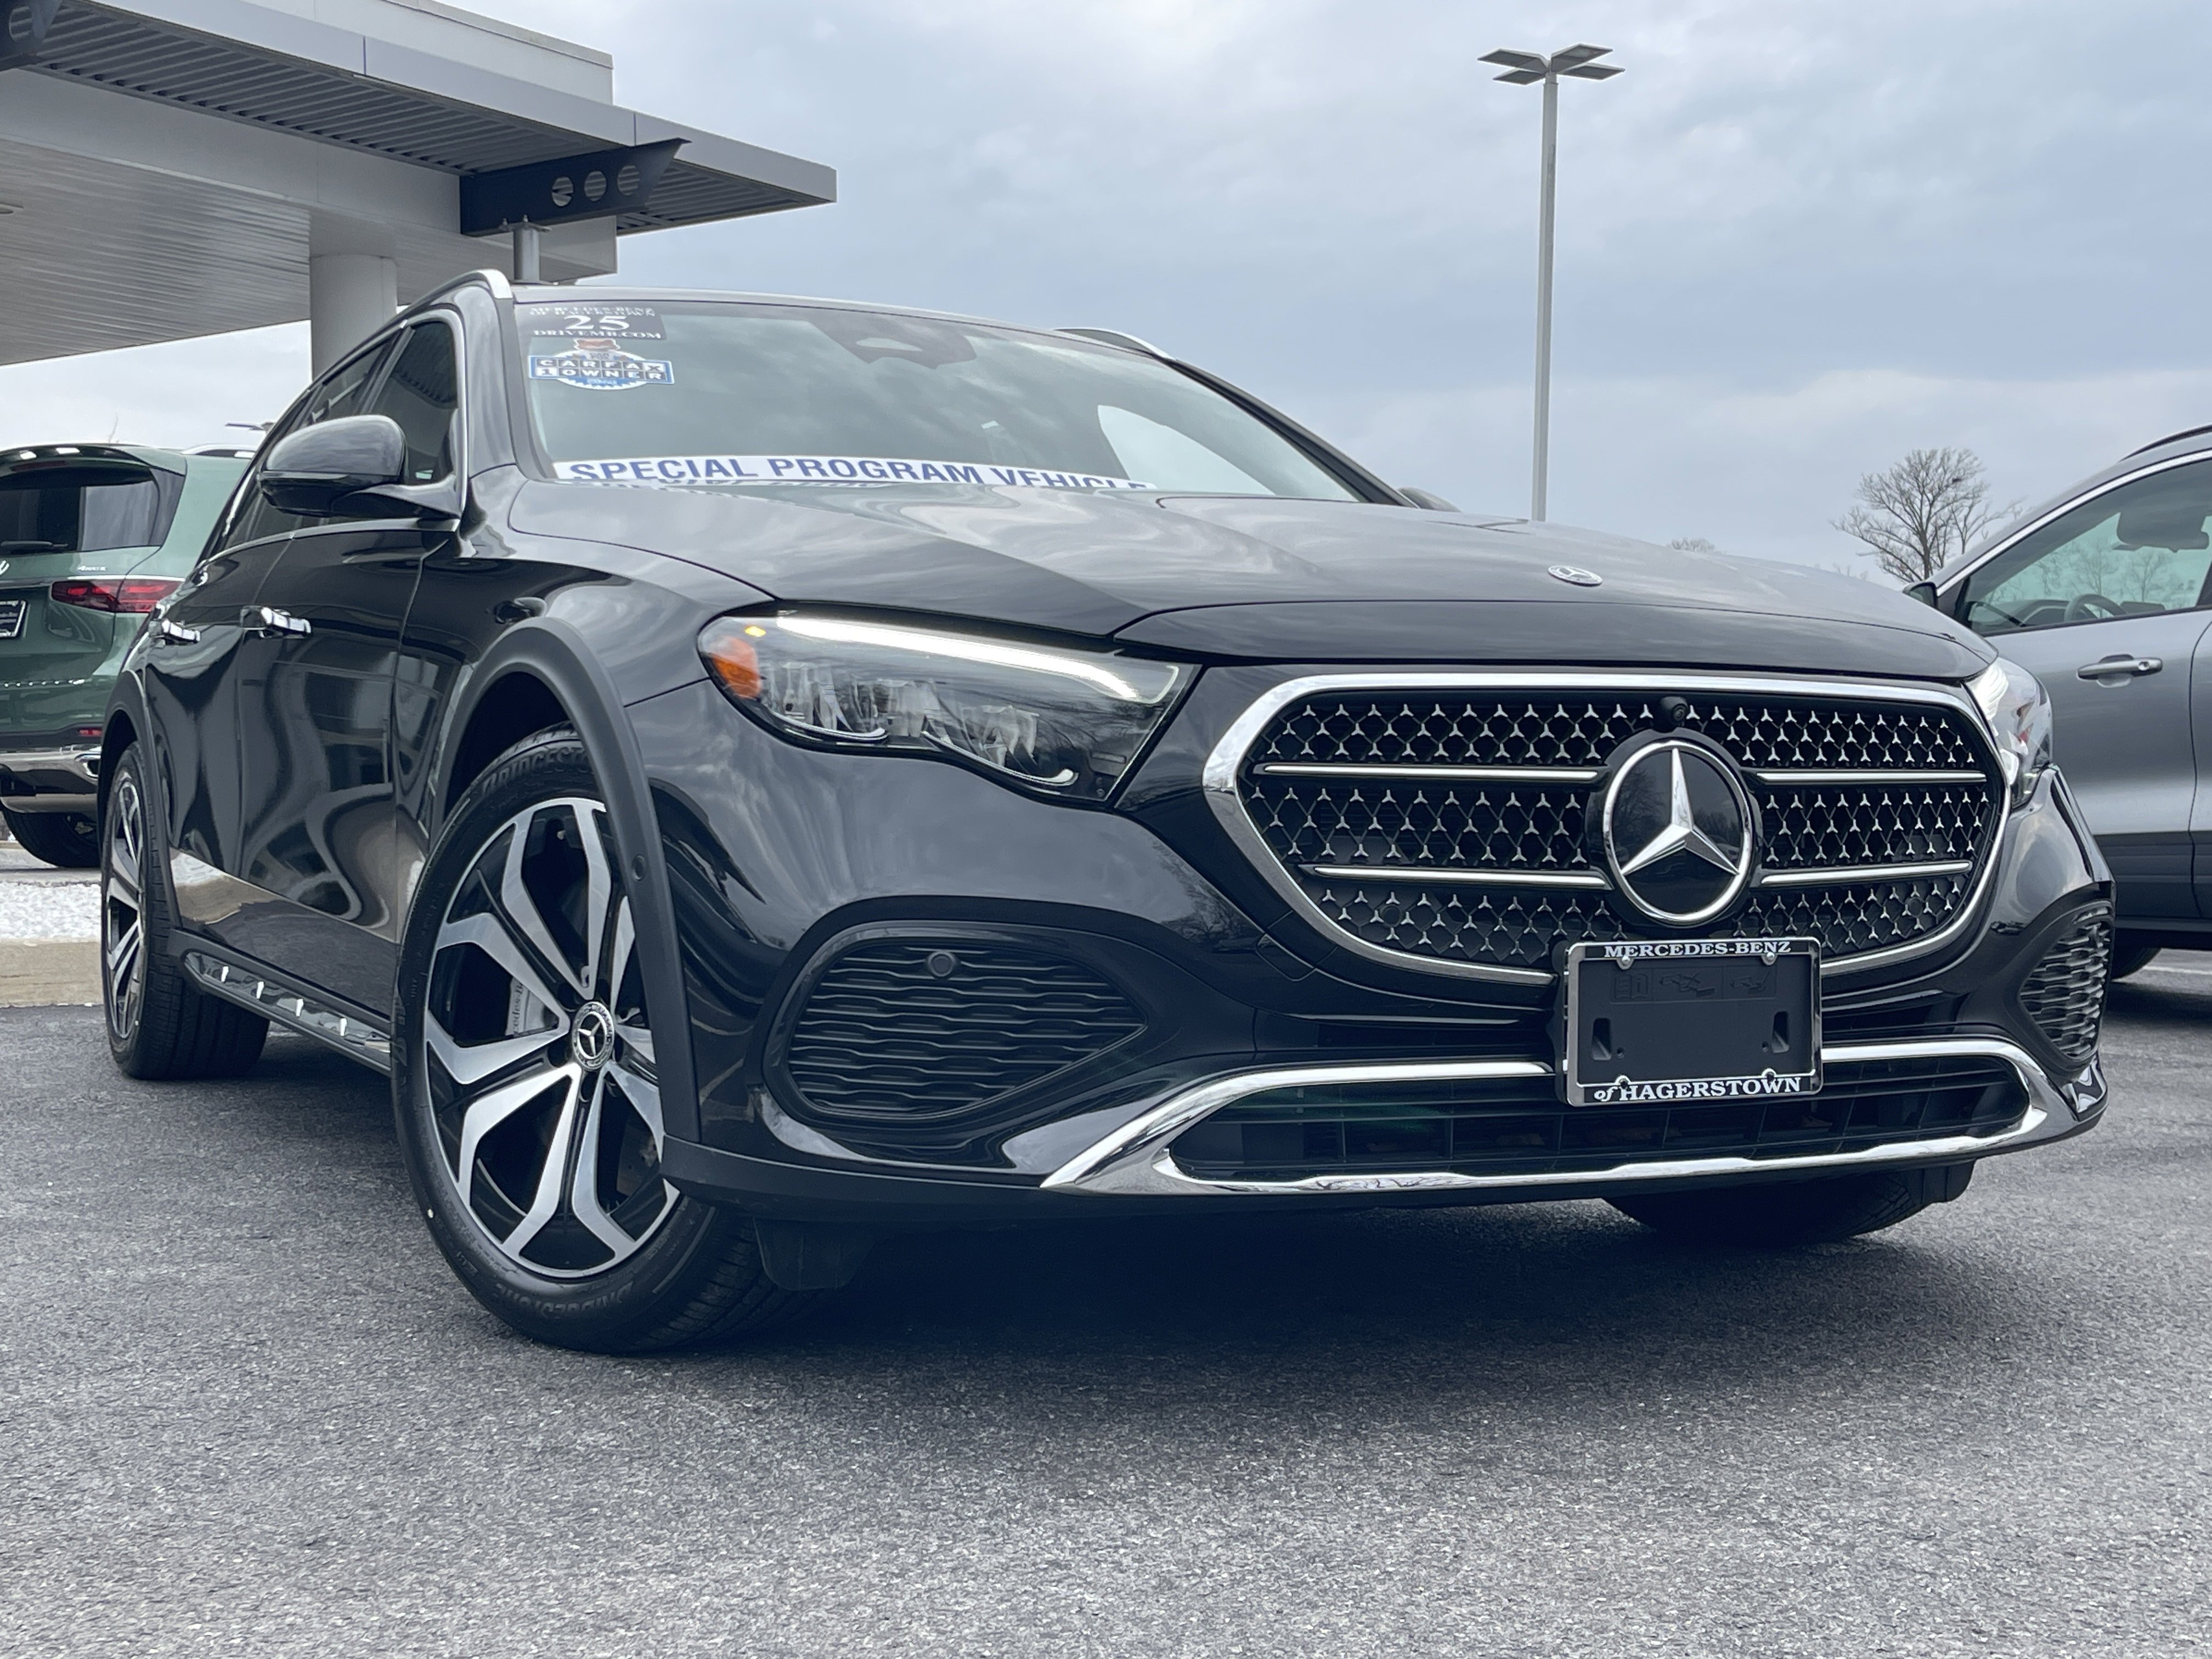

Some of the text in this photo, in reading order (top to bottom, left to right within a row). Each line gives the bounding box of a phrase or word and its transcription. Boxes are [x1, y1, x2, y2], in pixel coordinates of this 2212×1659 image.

[564, 315, 630, 330] 25
[540, 360, 663, 372] CARFAX
[541, 368, 662, 380] 1 OWNER
[570, 459, 759, 479] SPECIAL
[767, 459, 985, 484] PROGRAM
[1604, 941, 1791, 958] MERCEDES-BENZ
[1594, 1077, 1801, 1102] of HAGERSTOWN
